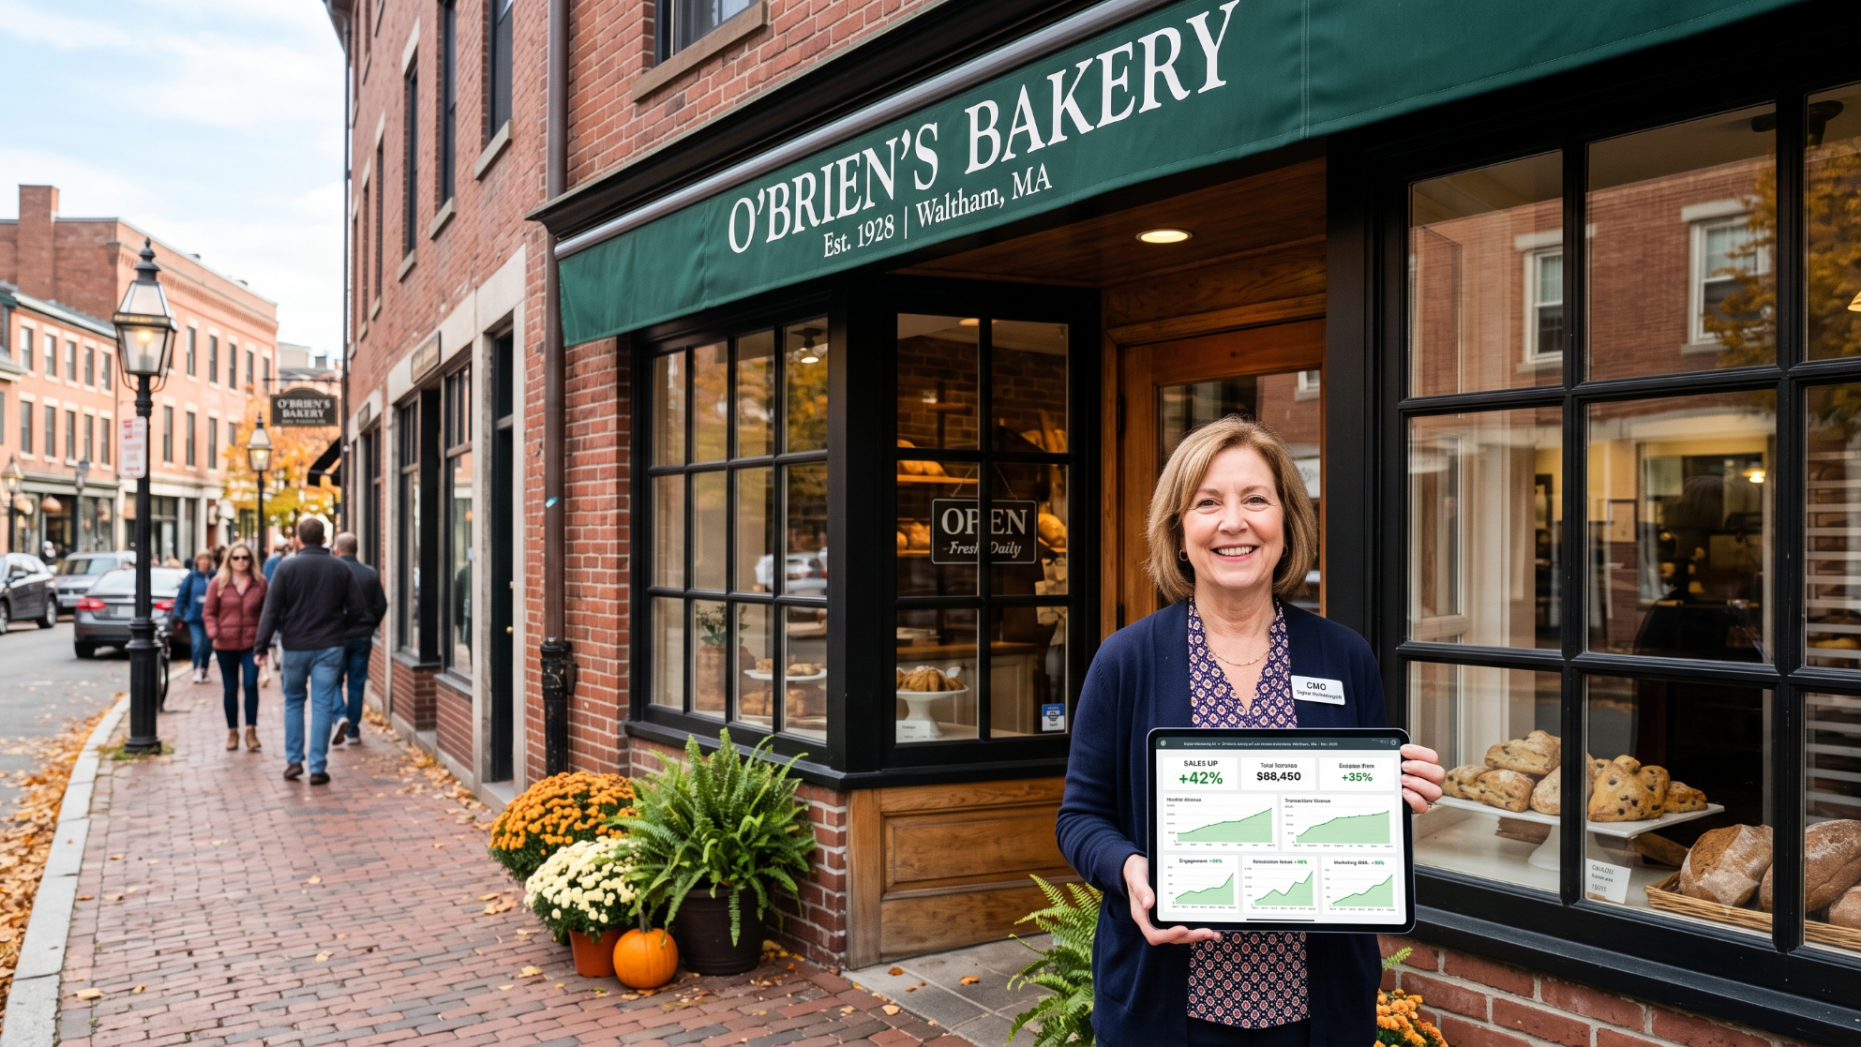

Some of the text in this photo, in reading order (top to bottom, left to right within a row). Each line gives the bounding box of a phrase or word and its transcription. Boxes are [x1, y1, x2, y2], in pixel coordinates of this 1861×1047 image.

[728, 0, 1240, 254] O'BRIEN'S BAKERY
[823, 231, 852, 258] Est.
[857, 213, 895, 248] 1928
[916, 187, 1005, 228] Waltham,
[1011, 162, 1053, 200] MA
[277, 399, 331, 409] O'BRIEN'S
[282, 409, 325, 418] BAKERY
[941, 507, 1028, 535] OPEN
[991, 541, 1022, 559] Daily
[1306, 681, 1327, 691] CMO
[1179, 771, 1223, 785] +42%
[1256, 771, 1302, 783] $88,450
[1341, 772, 1373, 782] +35%
